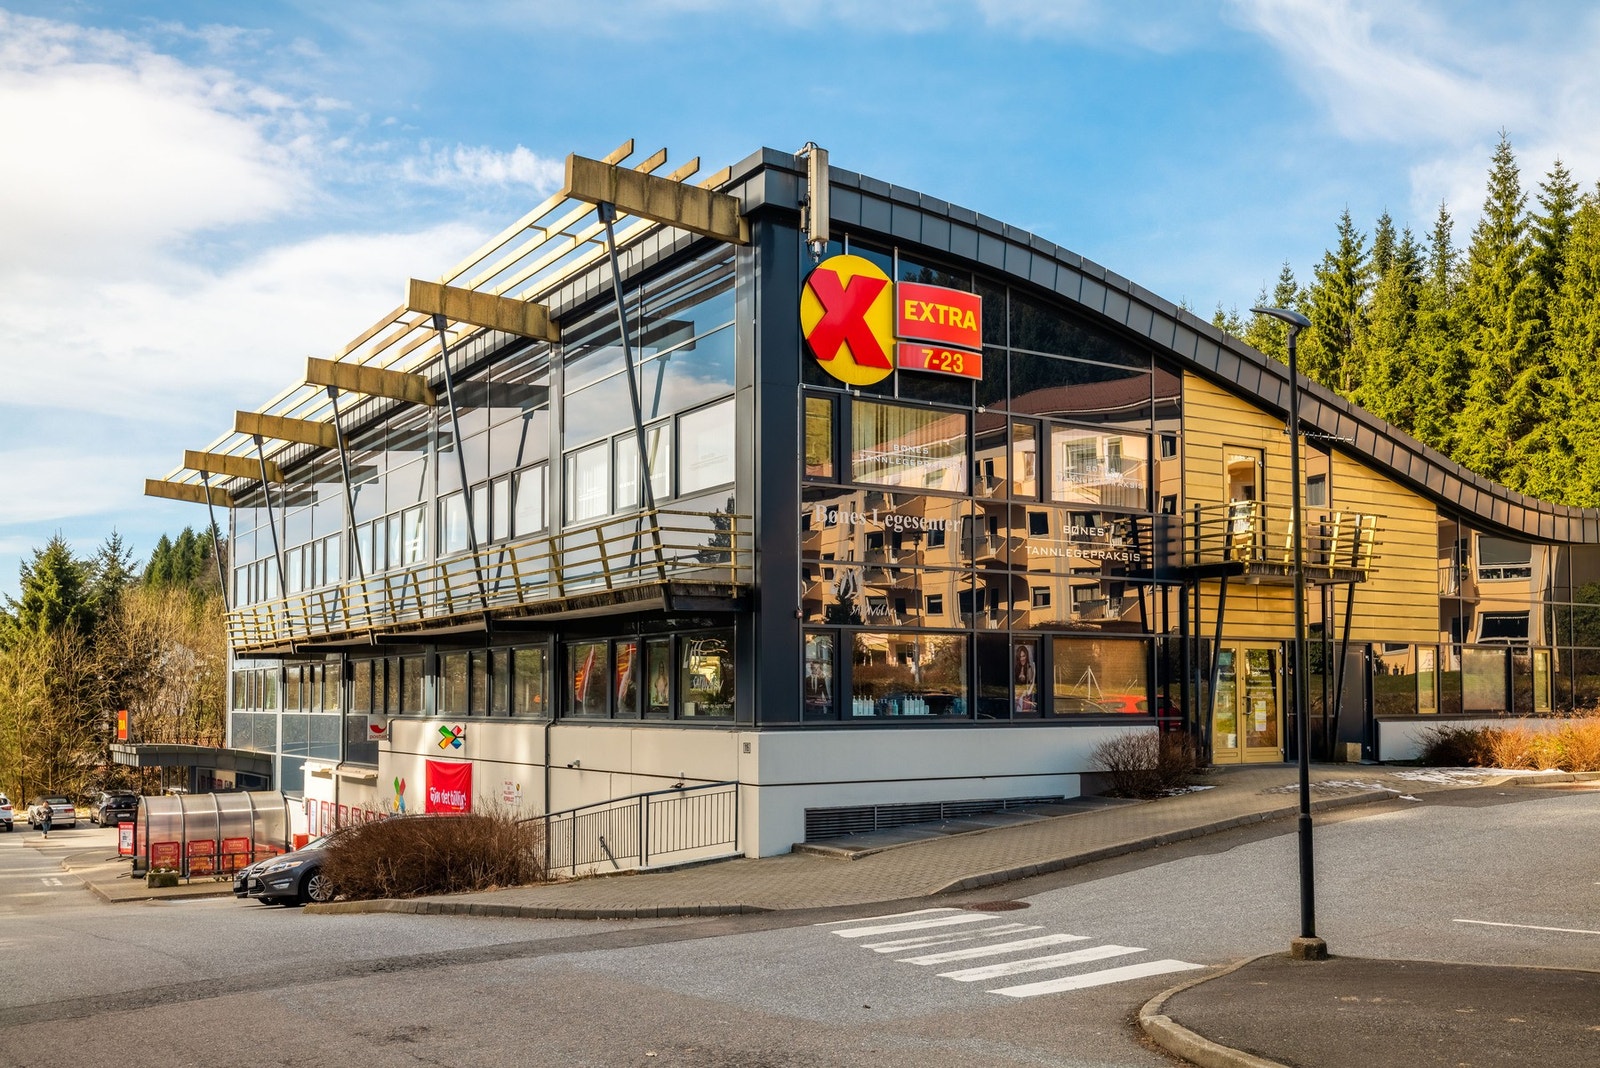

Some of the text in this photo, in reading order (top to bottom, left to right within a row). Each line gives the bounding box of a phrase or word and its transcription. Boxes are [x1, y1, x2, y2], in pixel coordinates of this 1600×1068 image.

[905, 299, 977, 331] EXTRA
[922, 349, 963, 374] 7-23
[815, 504, 960, 532] Bønes Legesenter
[1063, 525, 1104, 537] BØNES
[1025, 545, 1140, 562] TANNLEGEPRAKSIS
